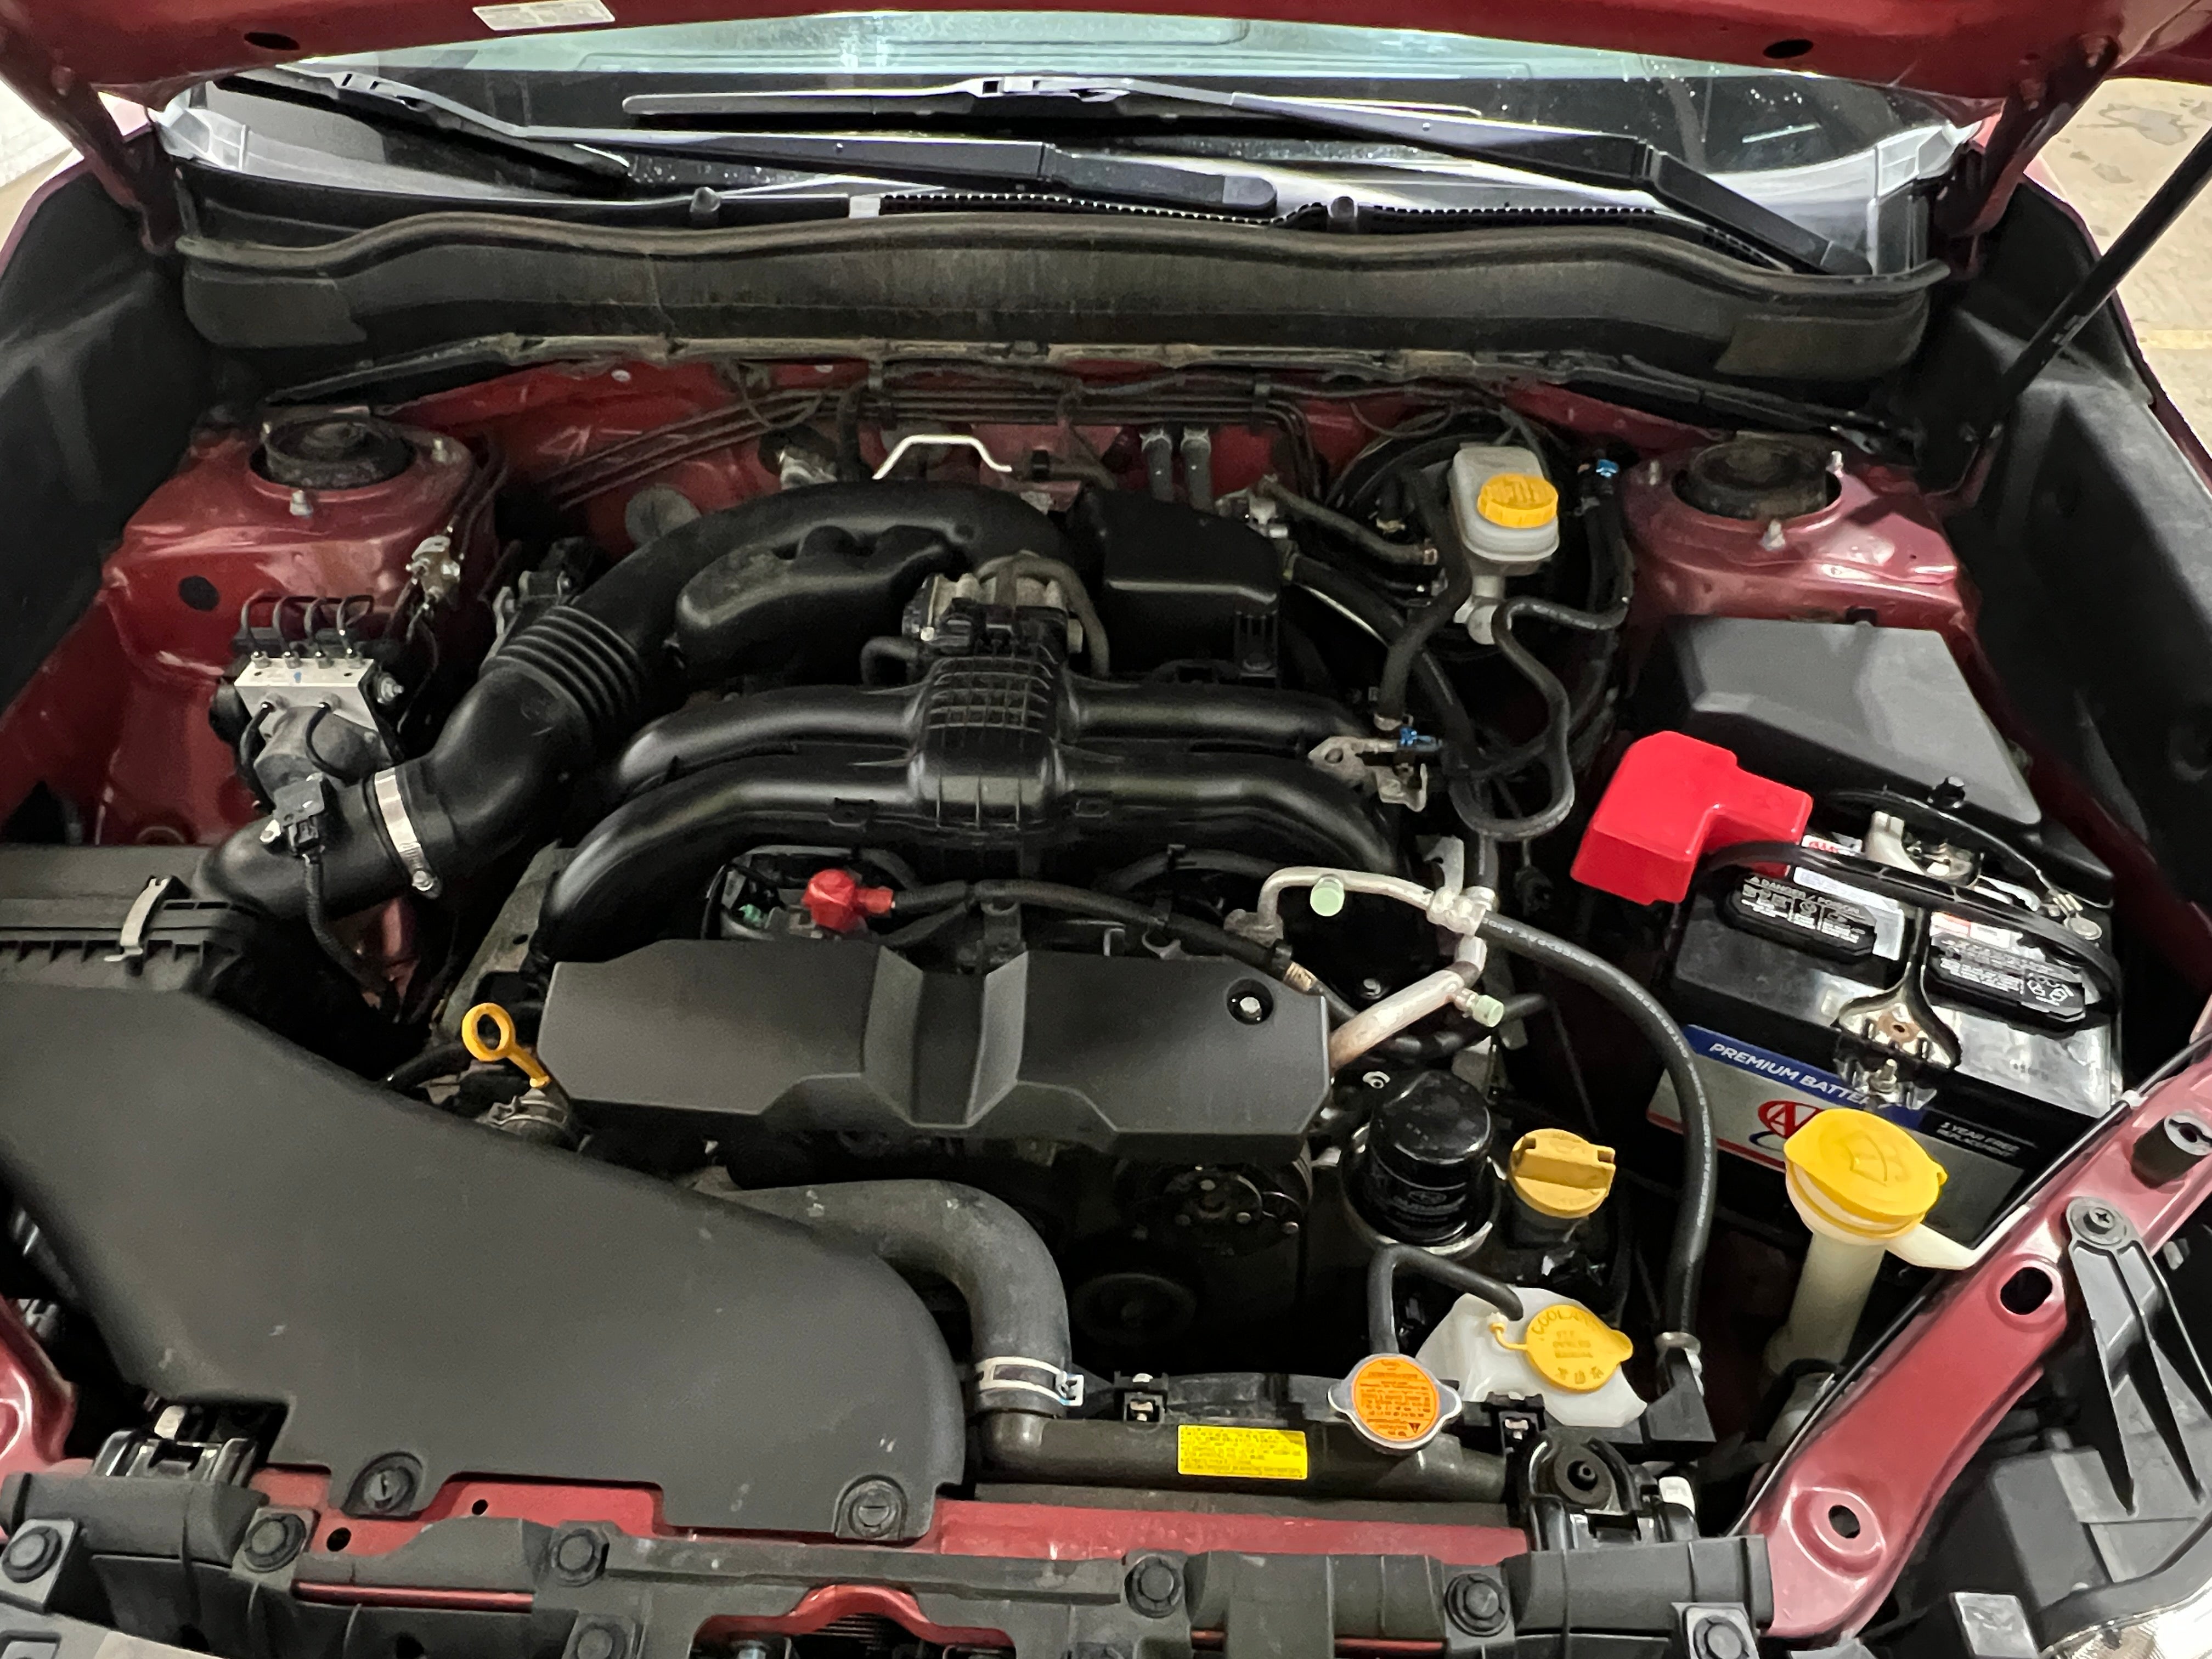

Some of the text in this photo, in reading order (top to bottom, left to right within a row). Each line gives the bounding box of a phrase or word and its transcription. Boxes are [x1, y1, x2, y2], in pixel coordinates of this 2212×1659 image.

[1709, 1043, 1799, 1081] PREMIUM
[1952, 1125, 1985, 1140] YEAR
[1984, 1137, 2021, 1153] FREE
